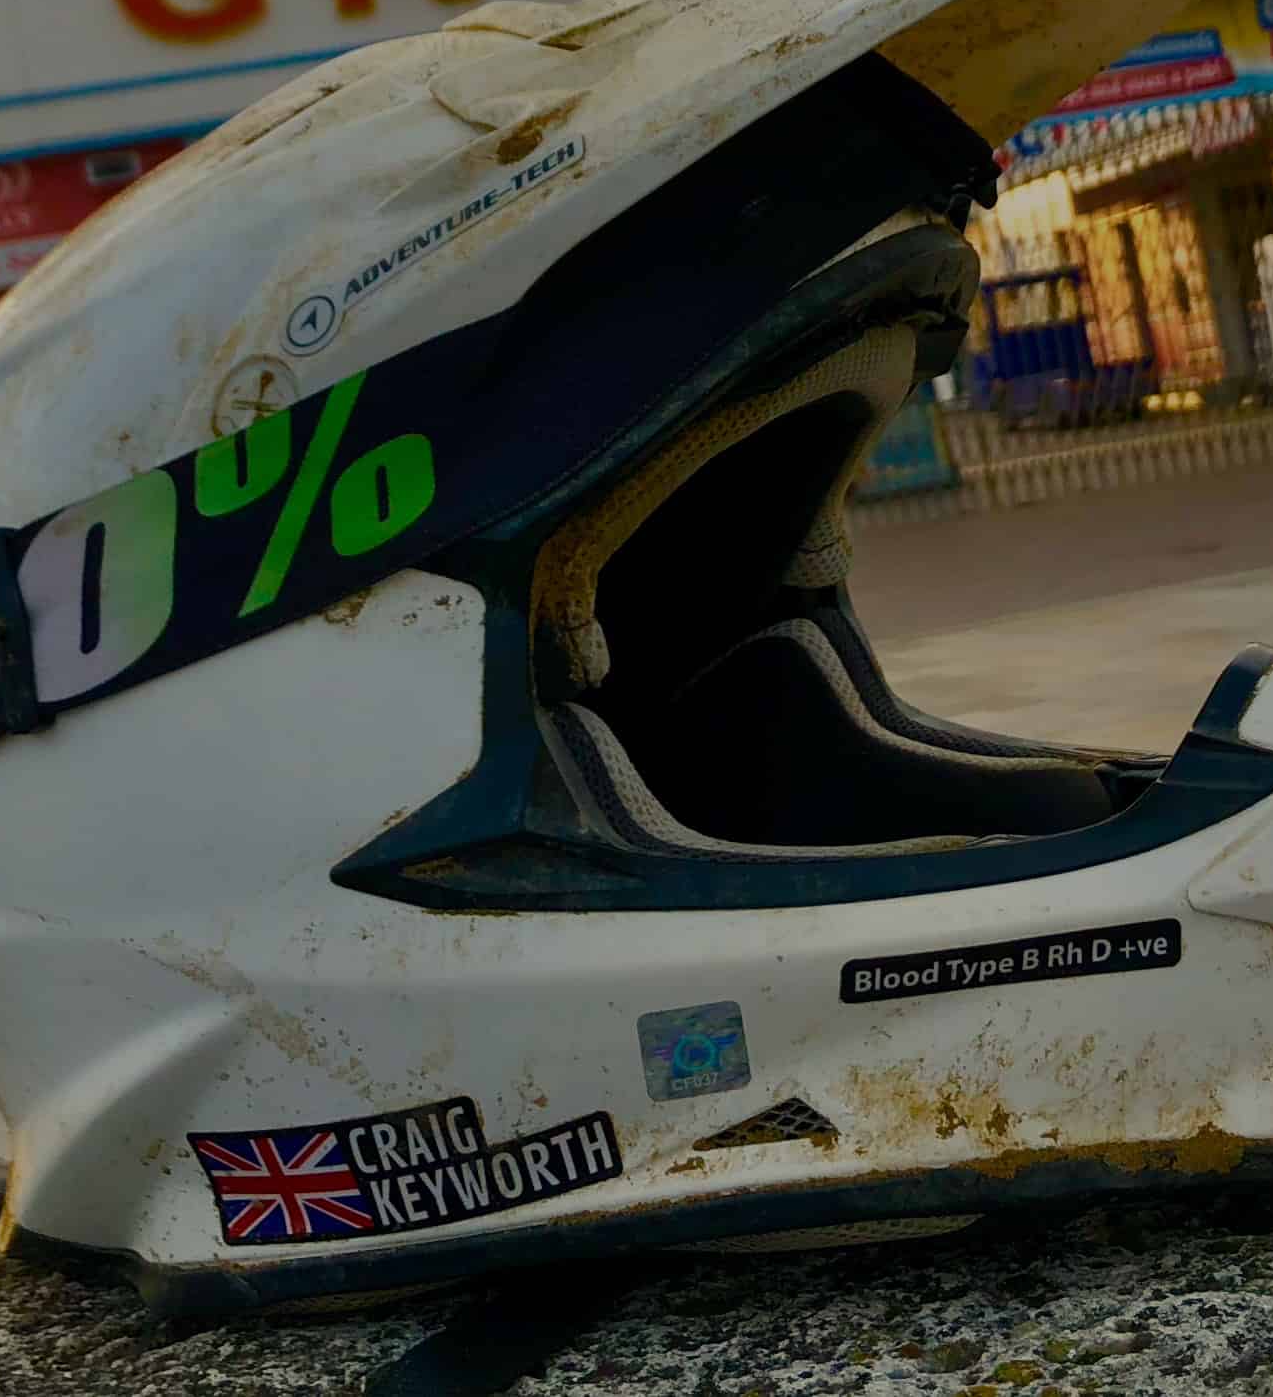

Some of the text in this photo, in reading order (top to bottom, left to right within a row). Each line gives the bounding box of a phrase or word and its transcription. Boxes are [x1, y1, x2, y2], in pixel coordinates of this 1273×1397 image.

[342, 141, 575, 303] ADVENTURE-TECH
[853, 935, 1168, 993] Blood Type B Rh D +ve
[348, 1105, 479, 1175] CRAIG
[370, 1120, 614, 1227] KEYWORTH
